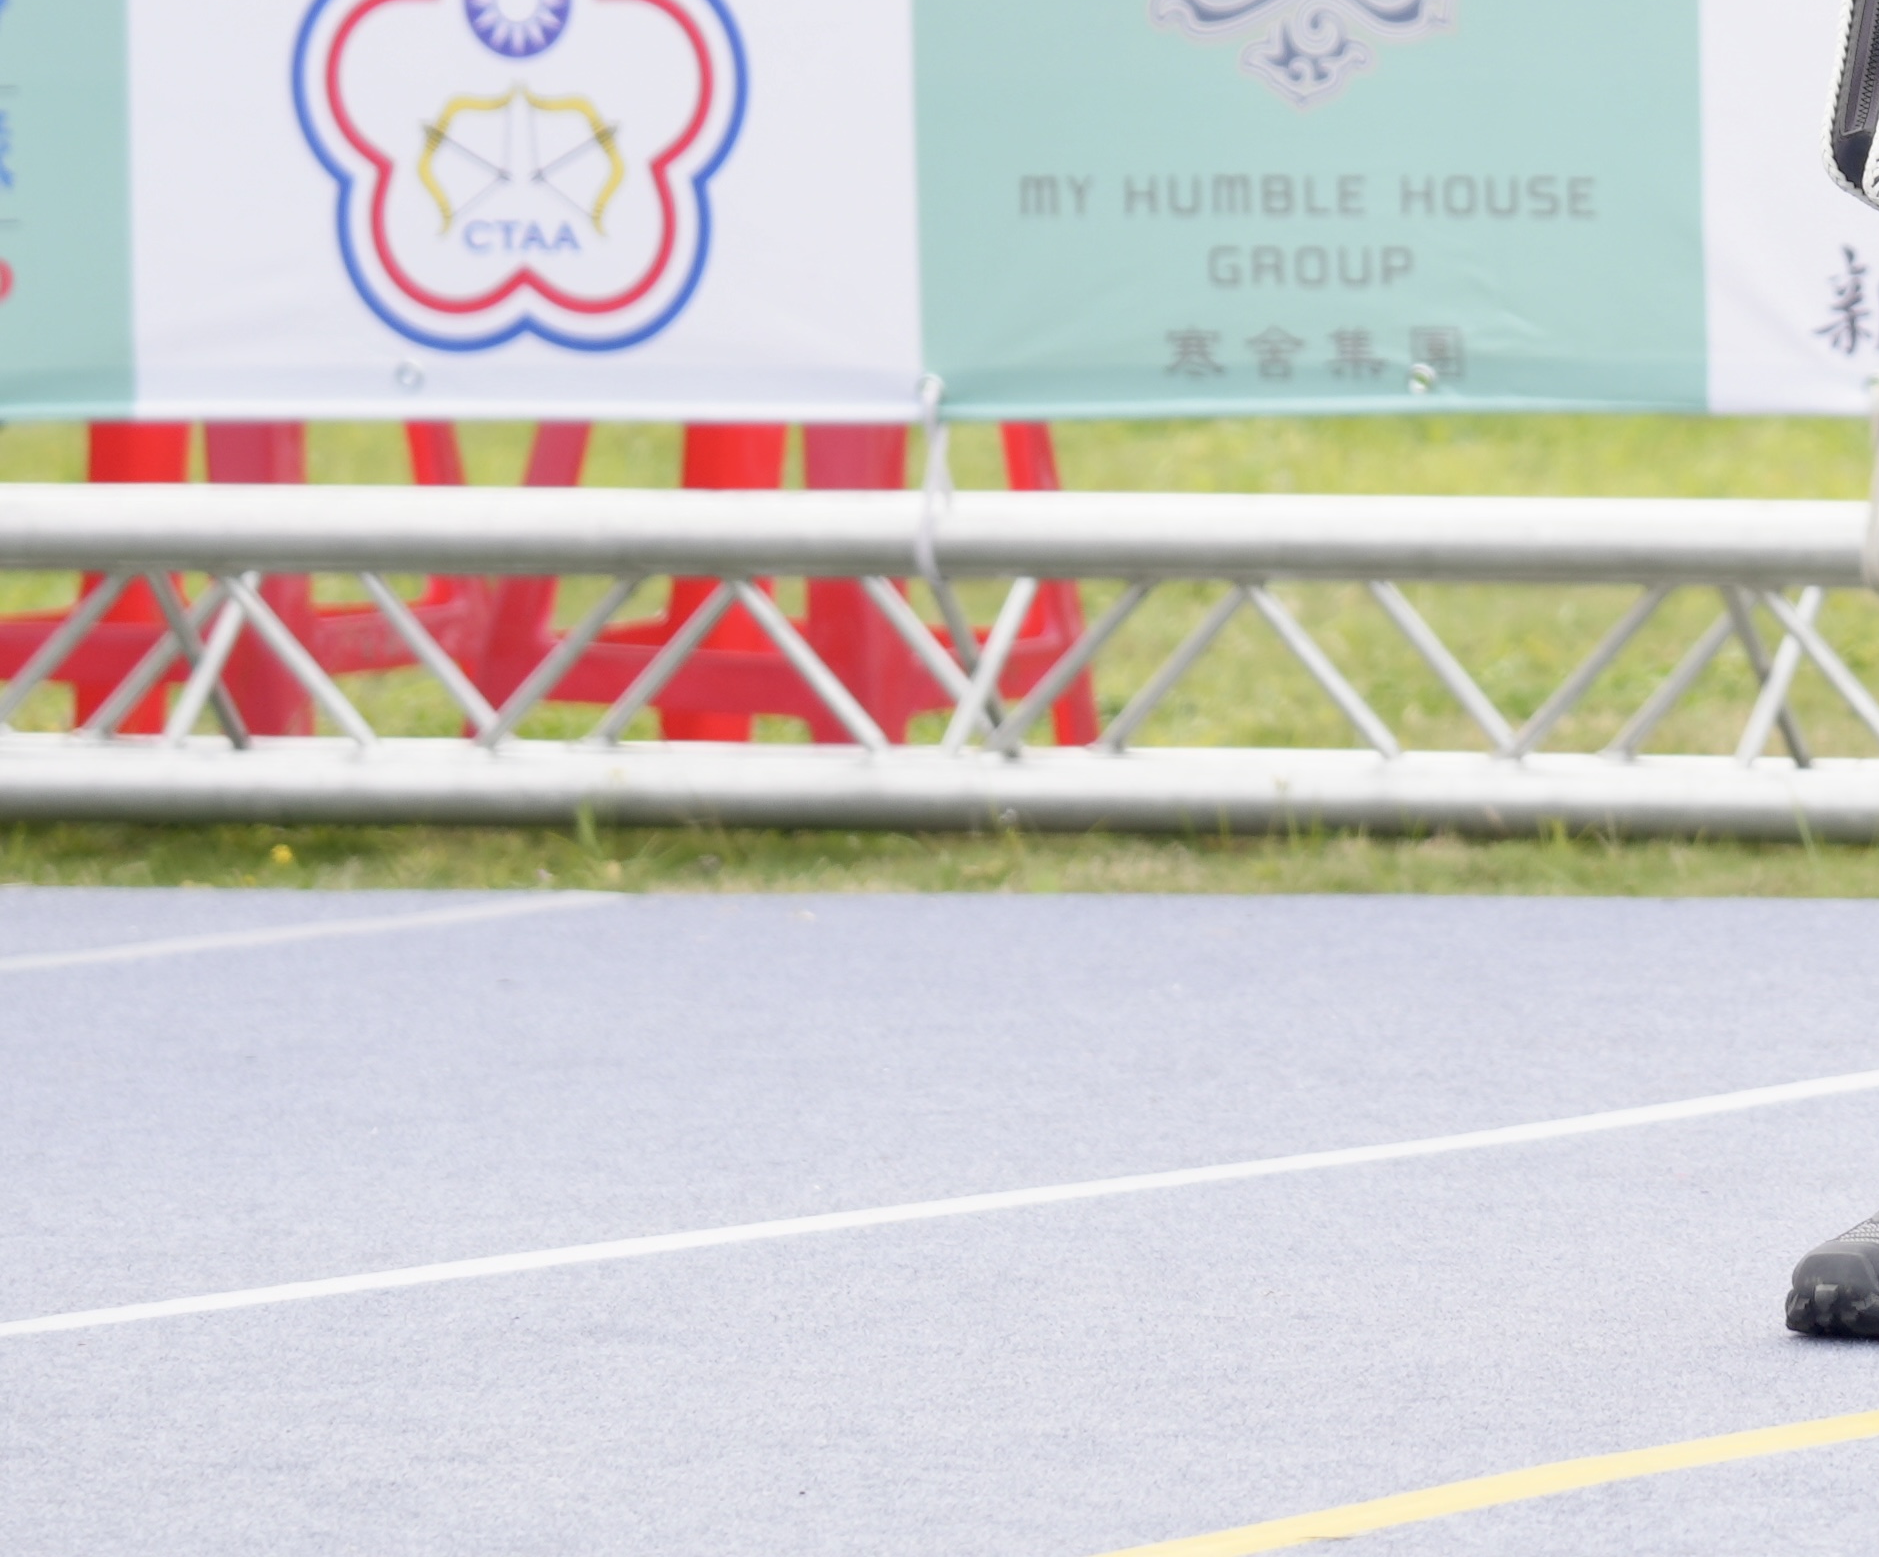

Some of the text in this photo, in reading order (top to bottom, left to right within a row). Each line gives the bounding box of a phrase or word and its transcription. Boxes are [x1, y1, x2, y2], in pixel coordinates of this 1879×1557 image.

[1018, 173, 1597, 220] MY HUMBLE HOUSE
[463, 218, 582, 255] CTAA
[1207, 244, 1415, 289] GROUP
[1164, 324, 1466, 382] 寒舍集團
